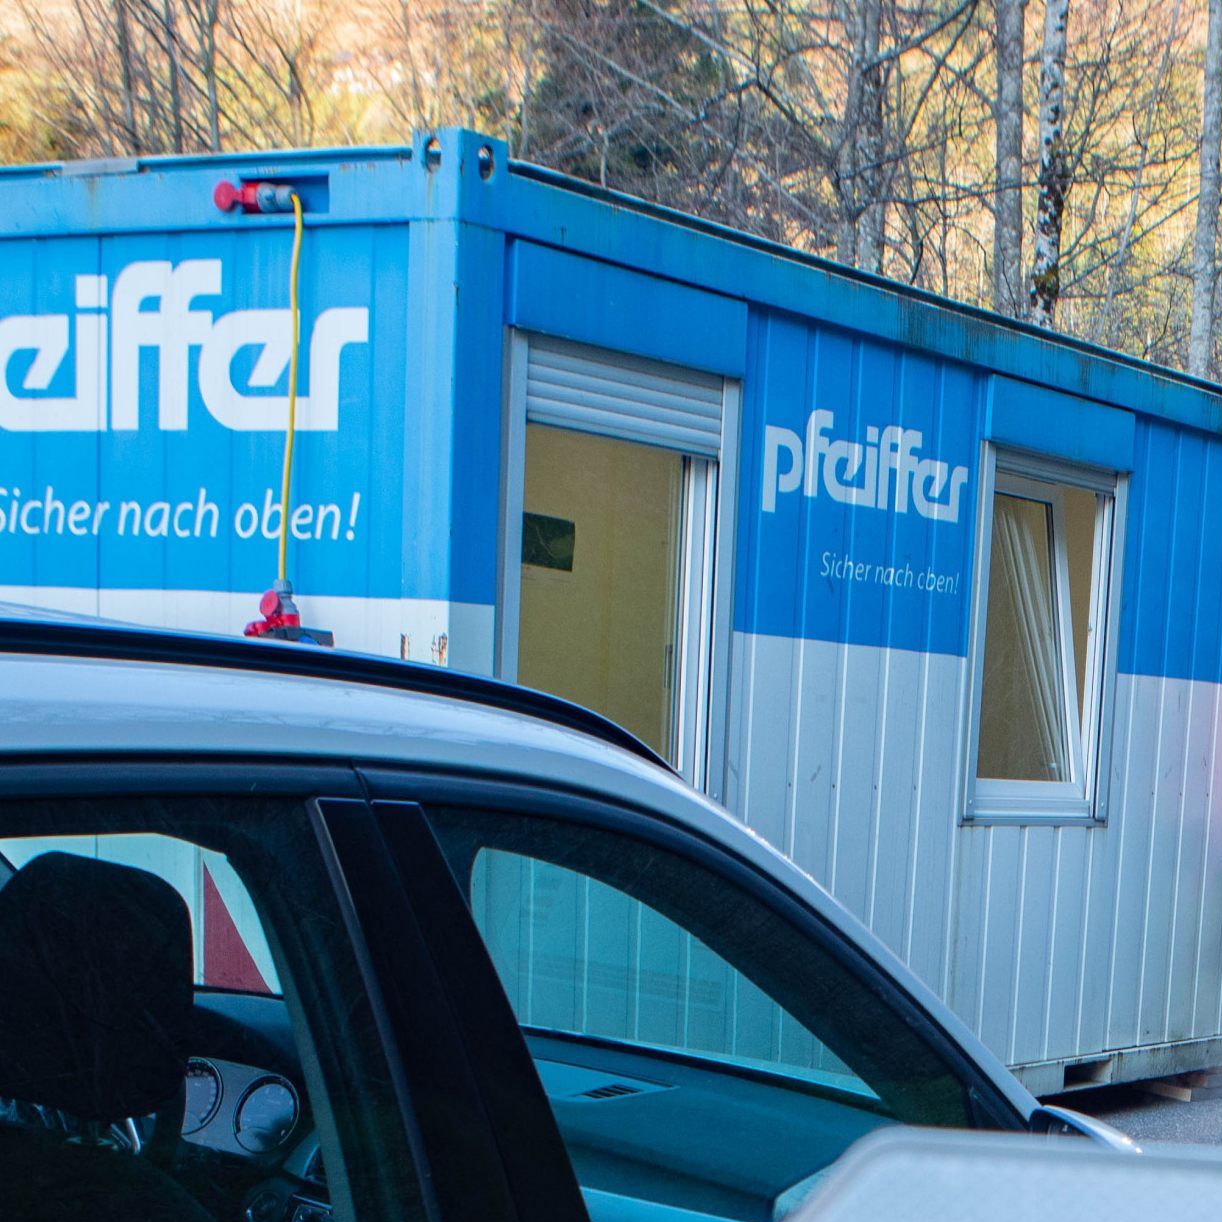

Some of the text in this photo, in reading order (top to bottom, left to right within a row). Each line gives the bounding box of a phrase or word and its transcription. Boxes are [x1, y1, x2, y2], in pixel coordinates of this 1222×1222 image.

[761, 408, 969, 524] pfeiffer
[117, 487, 220, 539] nach
[234, 488, 361, 542] oben!
[820, 551, 960, 595] Sicher nach oben!
